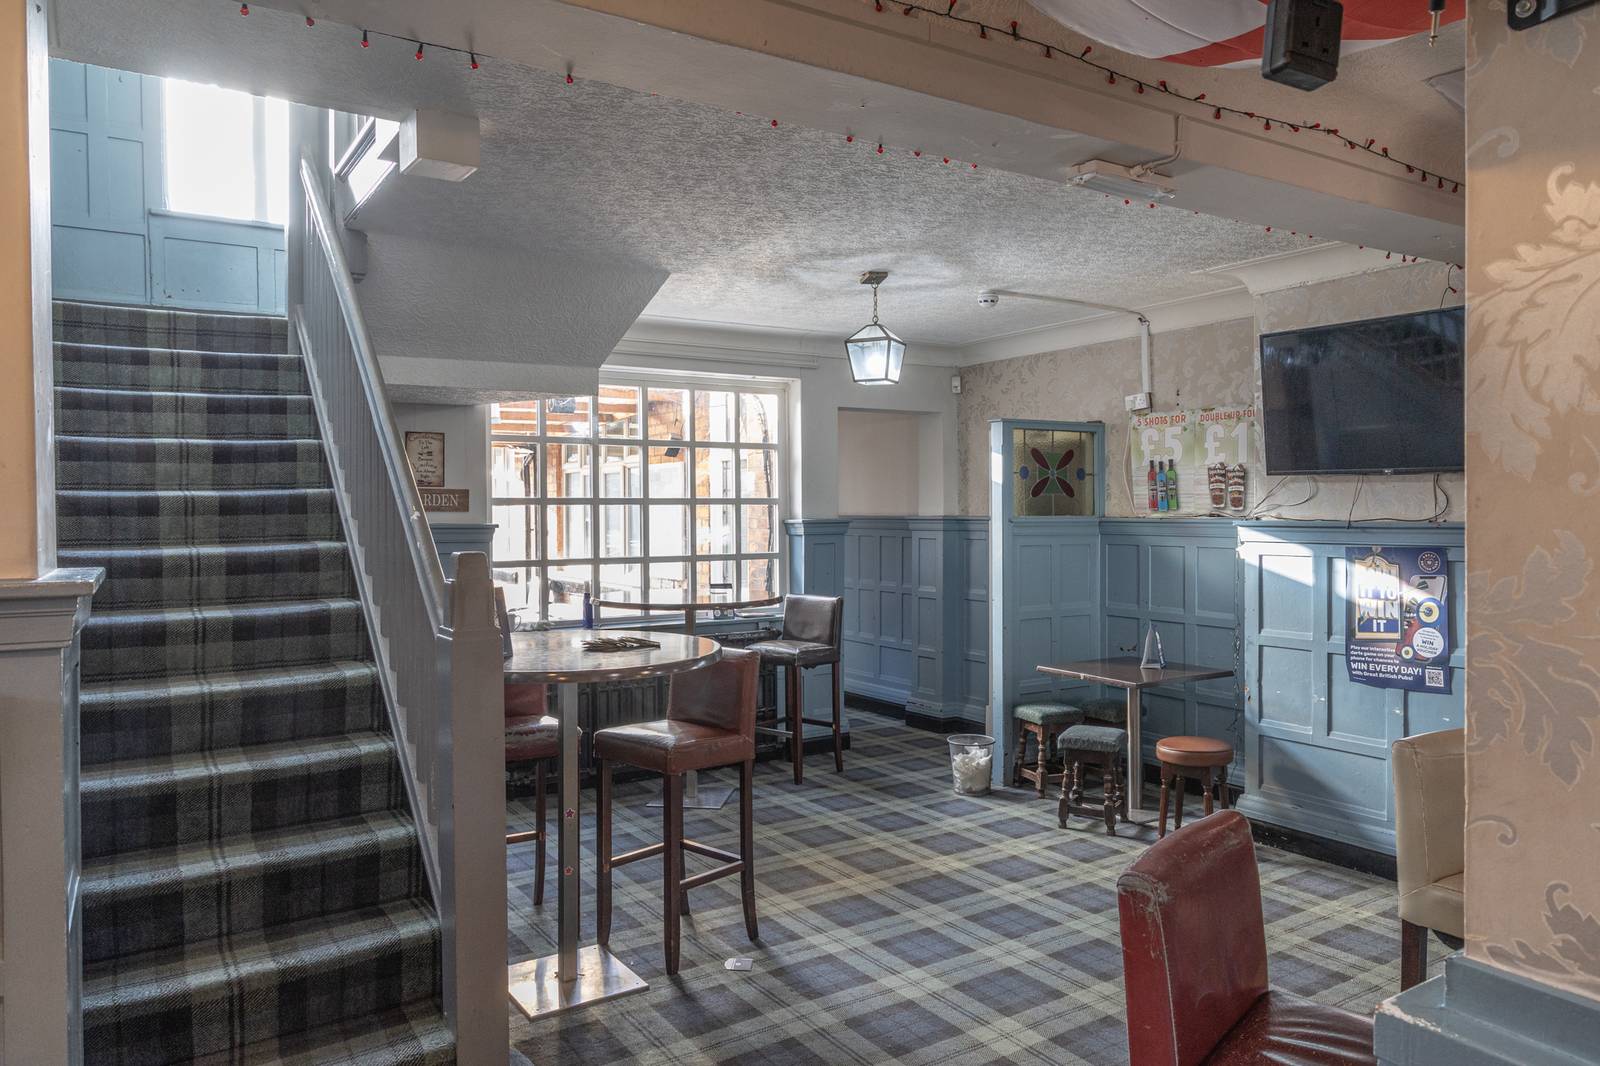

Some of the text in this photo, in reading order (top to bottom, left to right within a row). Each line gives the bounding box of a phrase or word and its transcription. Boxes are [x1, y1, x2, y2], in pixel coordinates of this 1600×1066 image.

[1144, 416, 1168, 426] SHOTS
[1171, 414, 1186, 423] FOR
[1200, 412, 1228, 422] DOUBLE
[1141, 426, 1183, 466] £5
[1204, 423, 1248, 464] £1
[1359, 599, 1399, 619] WIN
[1373, 619, 1387, 633] IT
[1421, 639, 1434, 647] WIN
[1350, 662, 1422, 675] WIN EVERY DAY!
